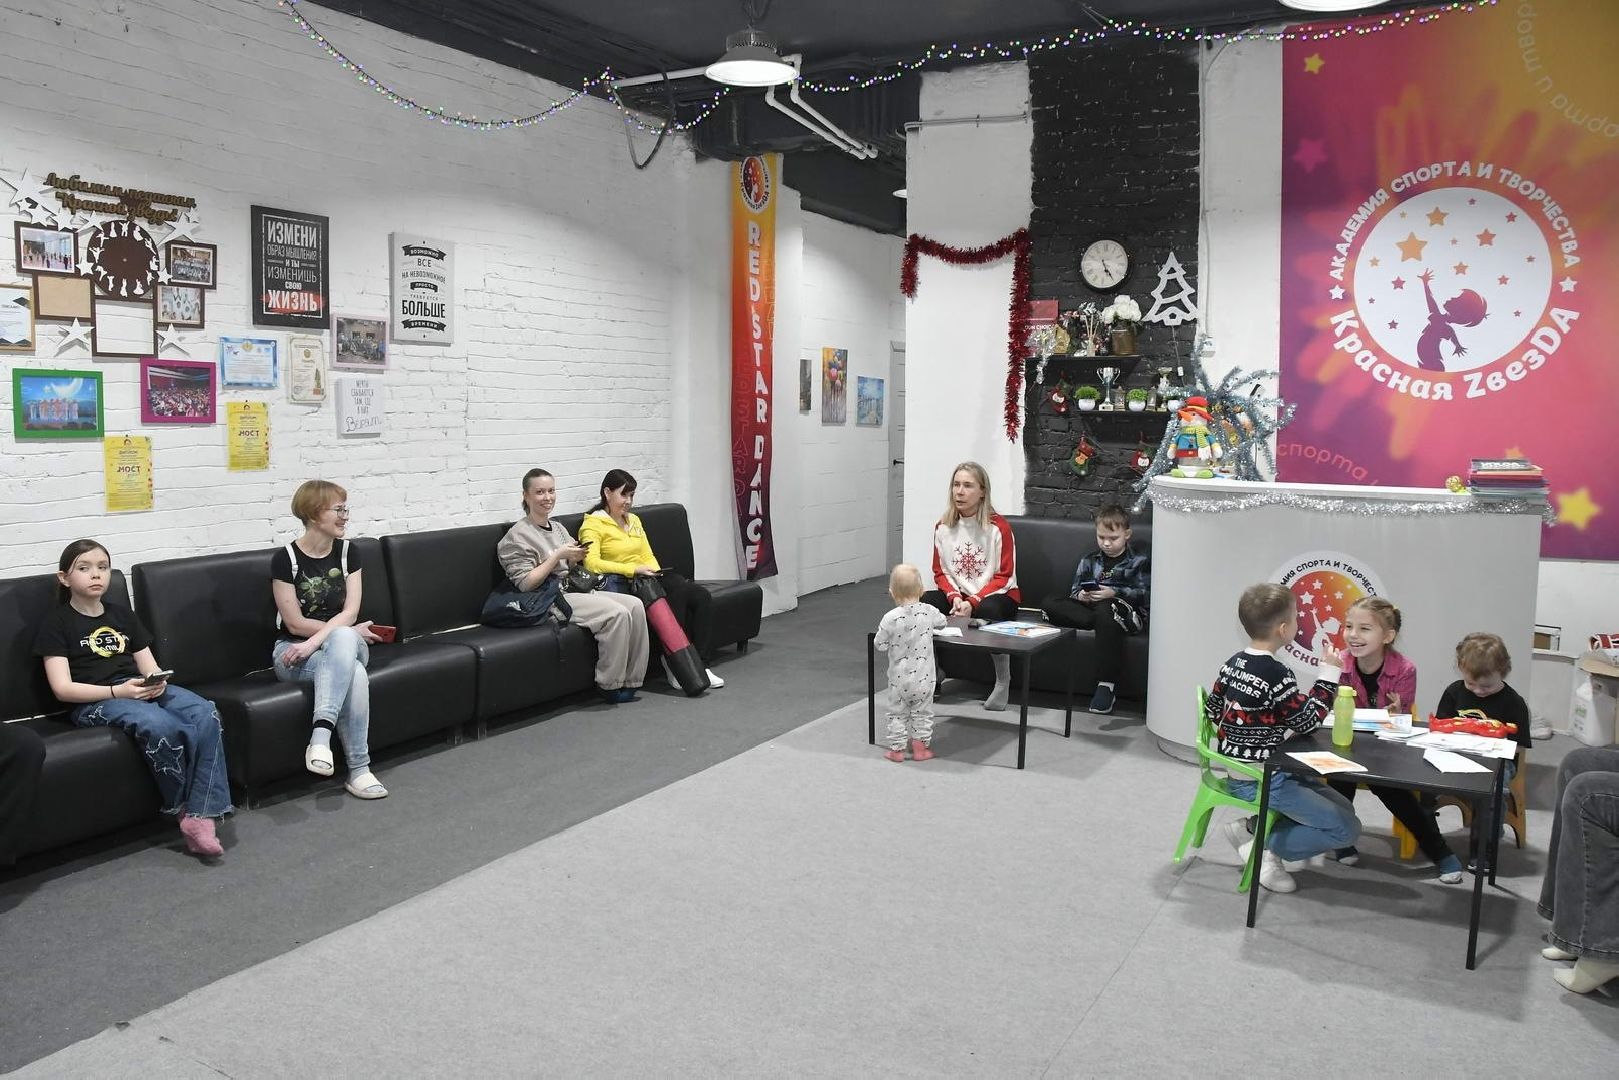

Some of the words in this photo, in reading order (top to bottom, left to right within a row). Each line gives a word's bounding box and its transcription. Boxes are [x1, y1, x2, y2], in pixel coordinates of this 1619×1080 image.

[1329, 188, 1390, 281] АКАДЕМИЯ
[1390, 160, 1472, 193] СПОРТА
[1476, 161, 1494, 179] И
[1498, 168, 1581, 268] ТВОРЧЕСТВА
[267, 220, 317, 248] ИЗМЕНИ
[266, 244, 285, 258] ОБРАЗ
[285, 246, 317, 261] МЫШЛЕНИЯ
[748, 221, 761, 302] RED
[285, 259, 290, 267] И
[291, 259, 300, 268] ТЫ
[417, 258, 432, 267] ВСЕ
[267, 266, 317, 283] ИЗМЕНИШЬ
[401, 271, 409, 279] НА
[409, 270, 446, 284] НЕВОЗМОЖНОЕ
[285, 281, 302, 290] СВОЮ
[267, 289, 318, 312] ЖИЗНЬ
[402, 300, 446, 318] БОЛЬШЕ
[1329, 309, 1454, 401] Красная
[752, 316, 768, 423] STAR
[117, 465, 141, 474] МОСТ
[1277, 443, 1369, 480] спорта
[746, 435, 765, 569] DANCE
[1296, 560, 1331, 573] СПОРТА
[1333, 560, 1341, 568] И
[1235, 657, 1248, 669] THE
[1230, 680, 1262, 698] JACOBS
